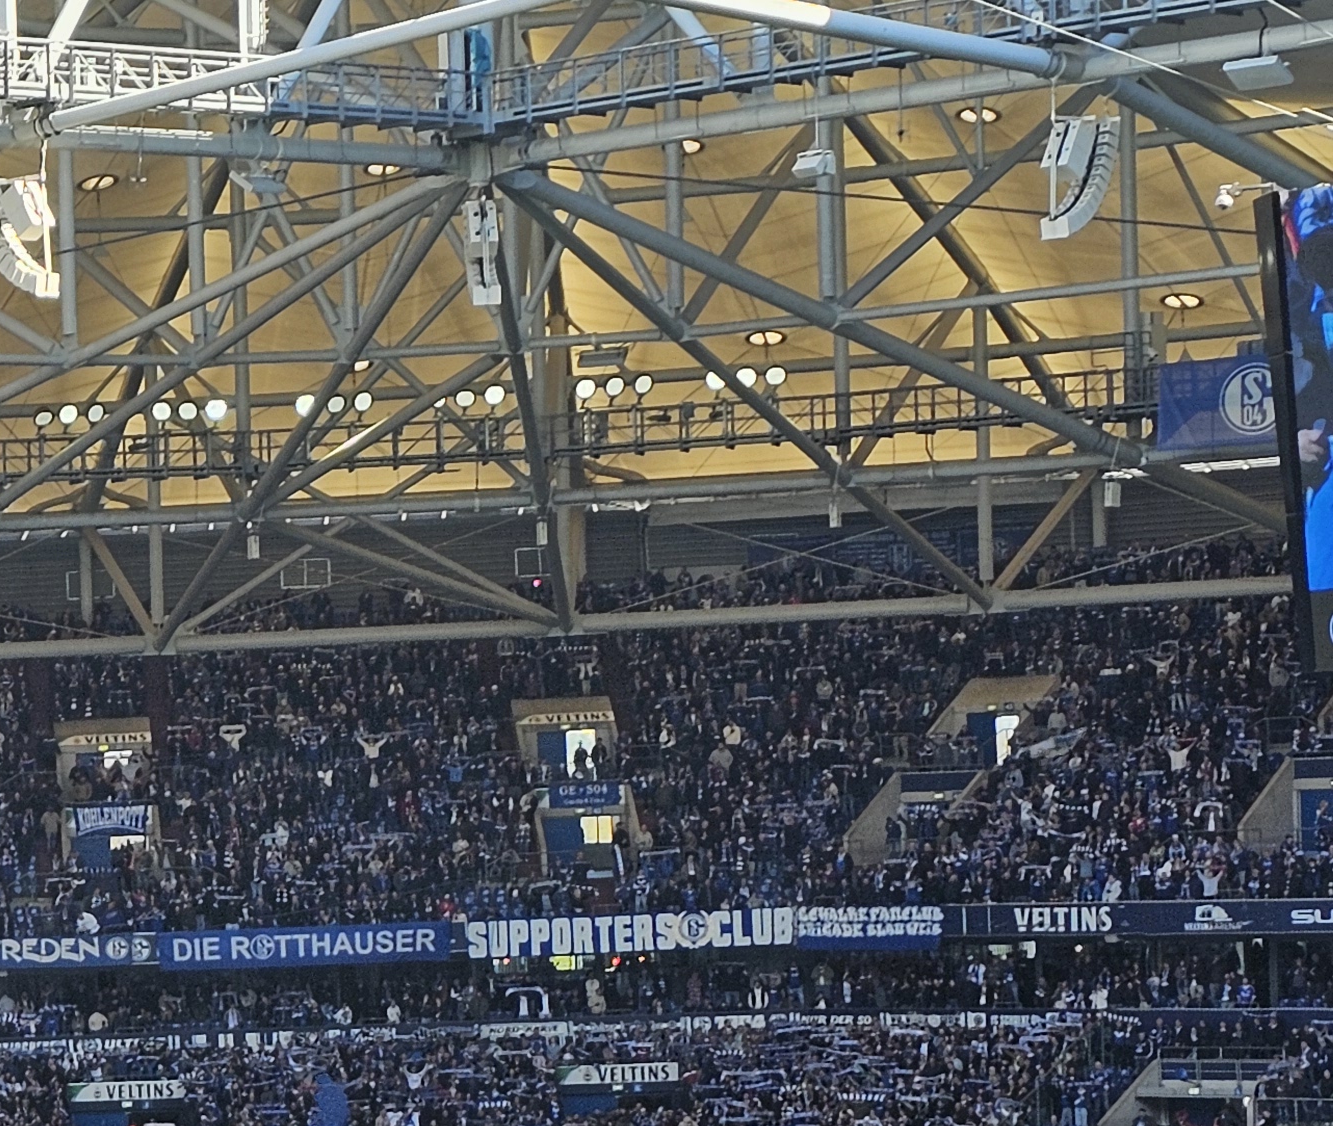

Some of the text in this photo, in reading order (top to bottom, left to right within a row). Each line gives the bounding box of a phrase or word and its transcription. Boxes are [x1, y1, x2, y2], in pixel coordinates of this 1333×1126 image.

[76, 805, 145, 831] KOHLENPOTT
[1013, 906, 1113, 932] VELTINS
[468, 907, 794, 959] SUPPORTERS CLUB
[172, 937, 222, 962] DIE
[597, 1064, 671, 1083] VELTINS
[105, 1083, 175, 1099] VELTINS
